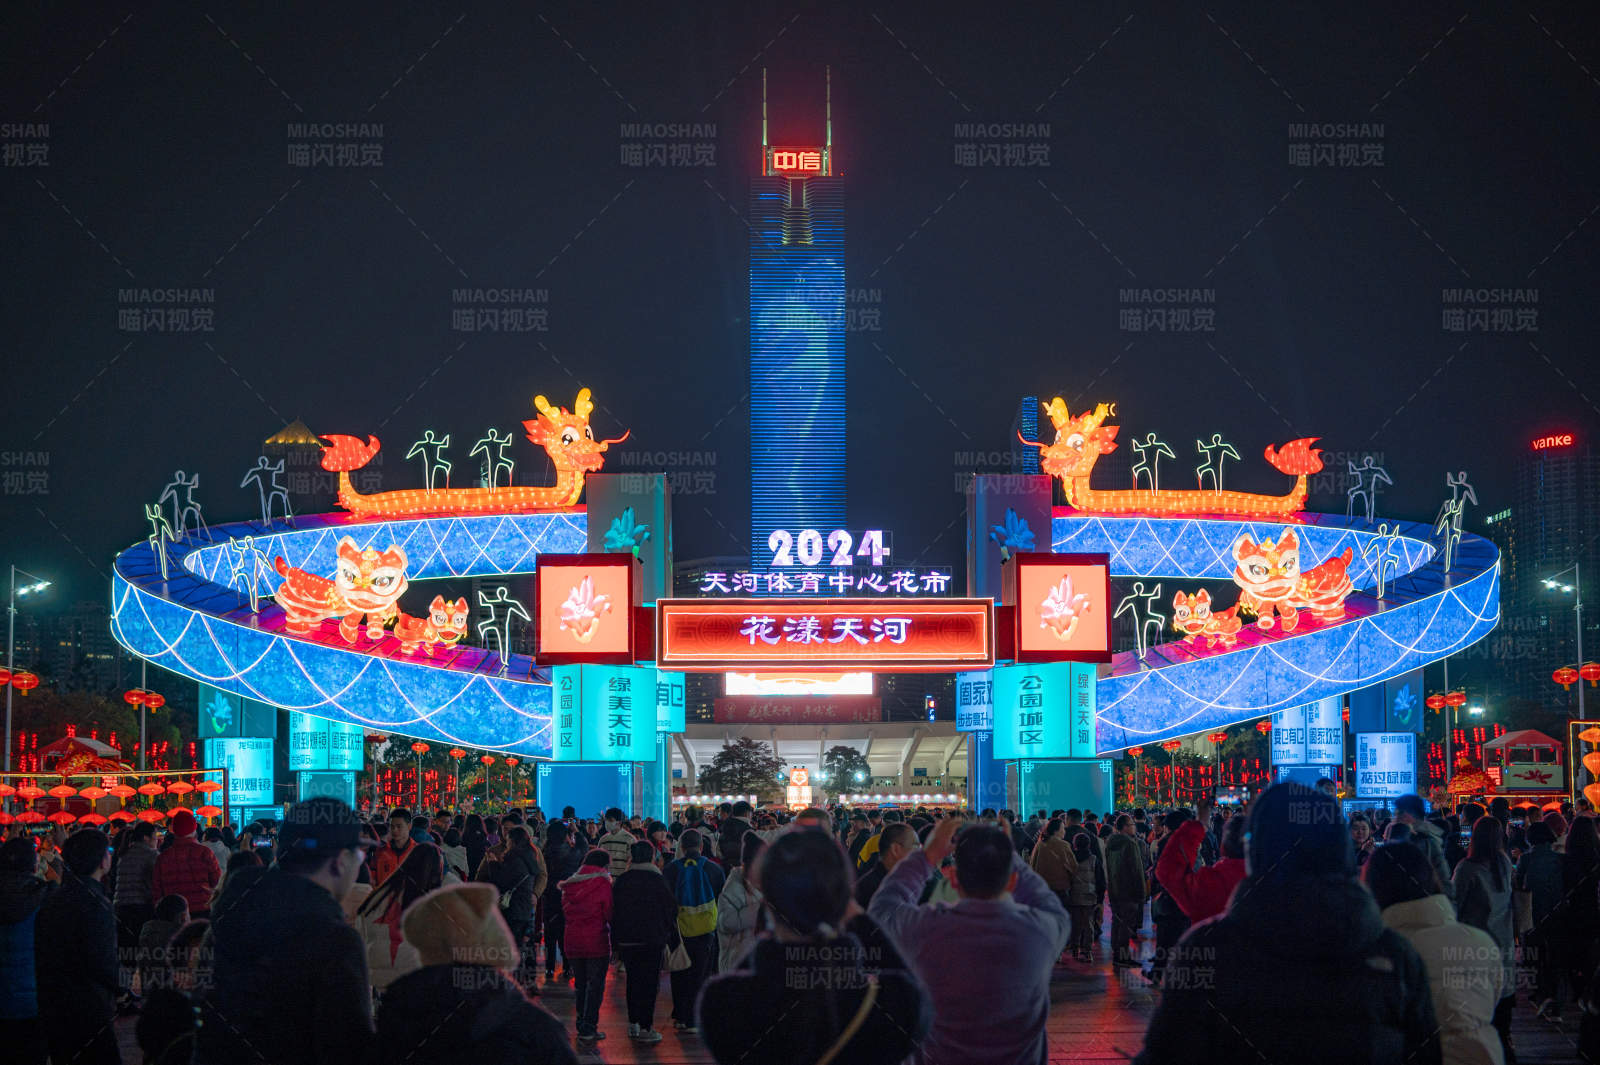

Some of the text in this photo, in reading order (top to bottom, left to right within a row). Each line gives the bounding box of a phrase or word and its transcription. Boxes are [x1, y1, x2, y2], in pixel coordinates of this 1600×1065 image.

[774, 151, 821, 170] 中信
[767, 528, 891, 568] 2024
[699, 571, 952, 594] 天河体育中心花市
[739, 615, 913, 646] 花漾天河
[560, 676, 573, 748] 公园城区
[608, 676, 633, 747] 绿美天河
[1019, 675, 1043, 745] 公园城区
[1077, 673, 1089, 744] 绿美天河
